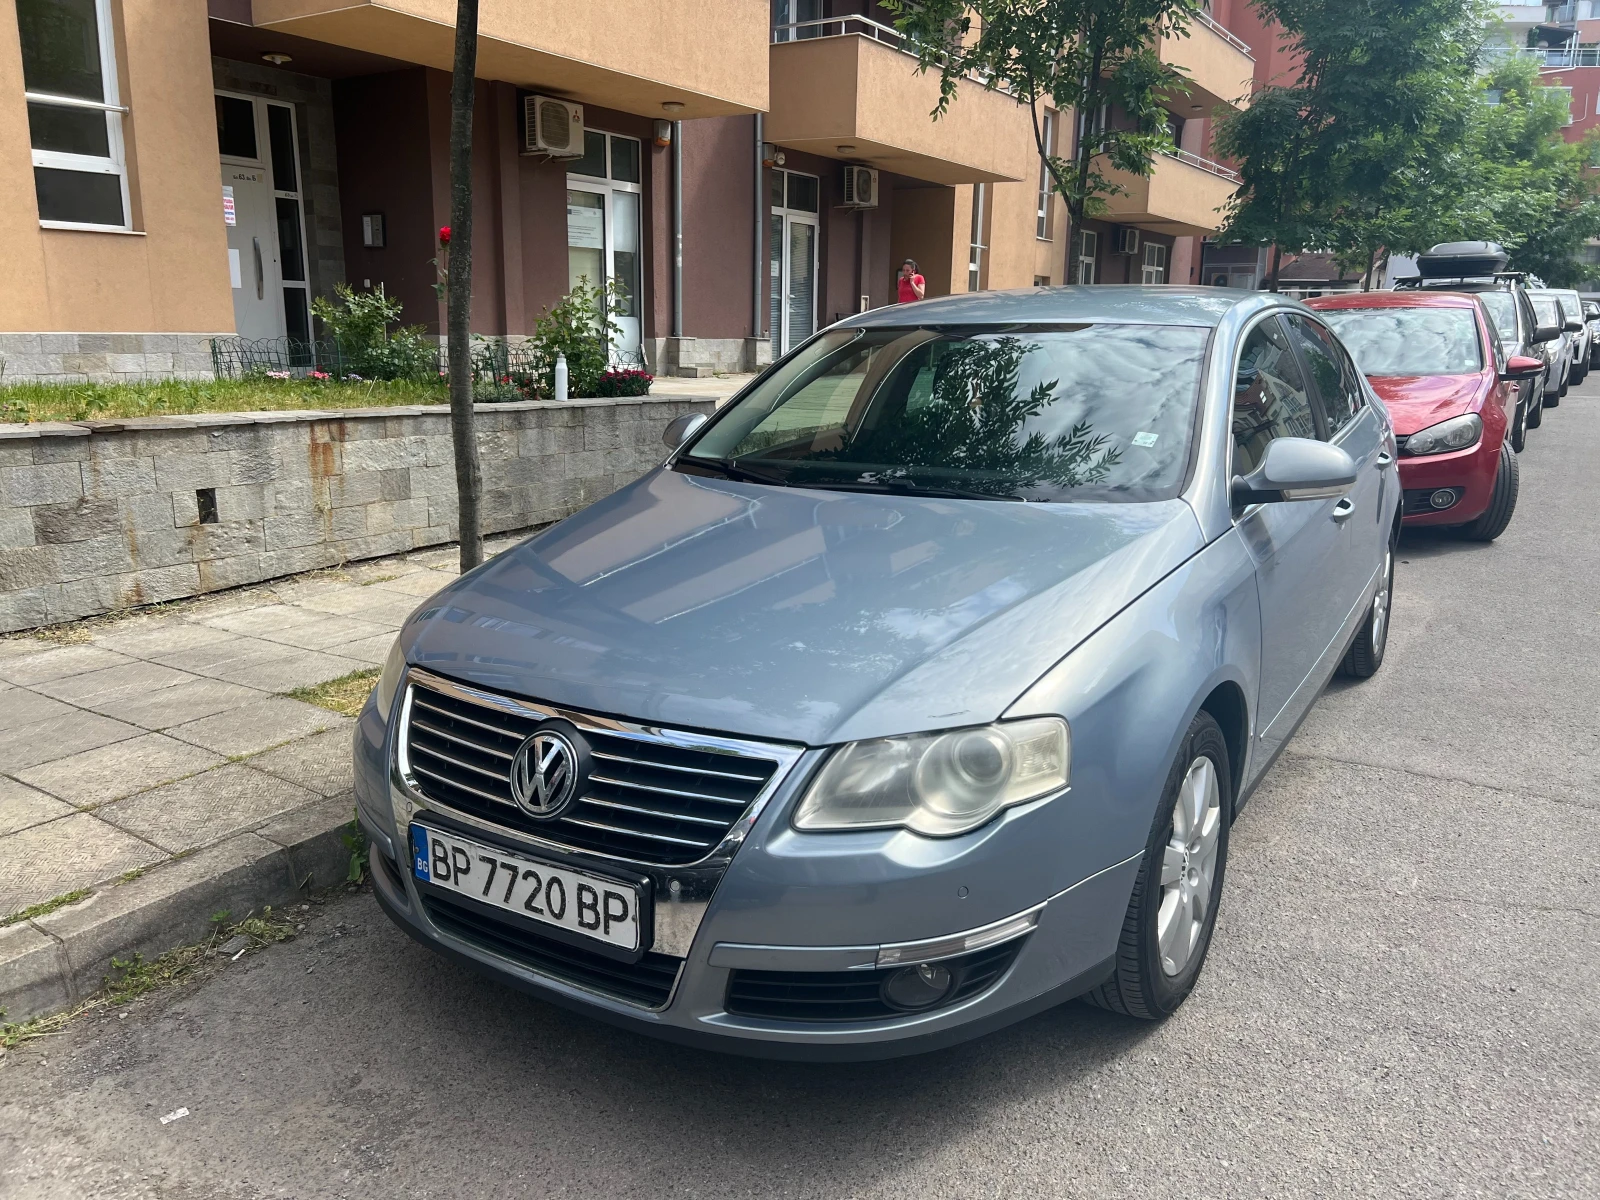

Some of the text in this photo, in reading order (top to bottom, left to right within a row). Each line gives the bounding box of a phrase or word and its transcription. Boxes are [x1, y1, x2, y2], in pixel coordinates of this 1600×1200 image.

[513, 735, 573, 814] VW
[417, 857, 429, 873] BG
[431, 837, 629, 936] BP 7720 BP
